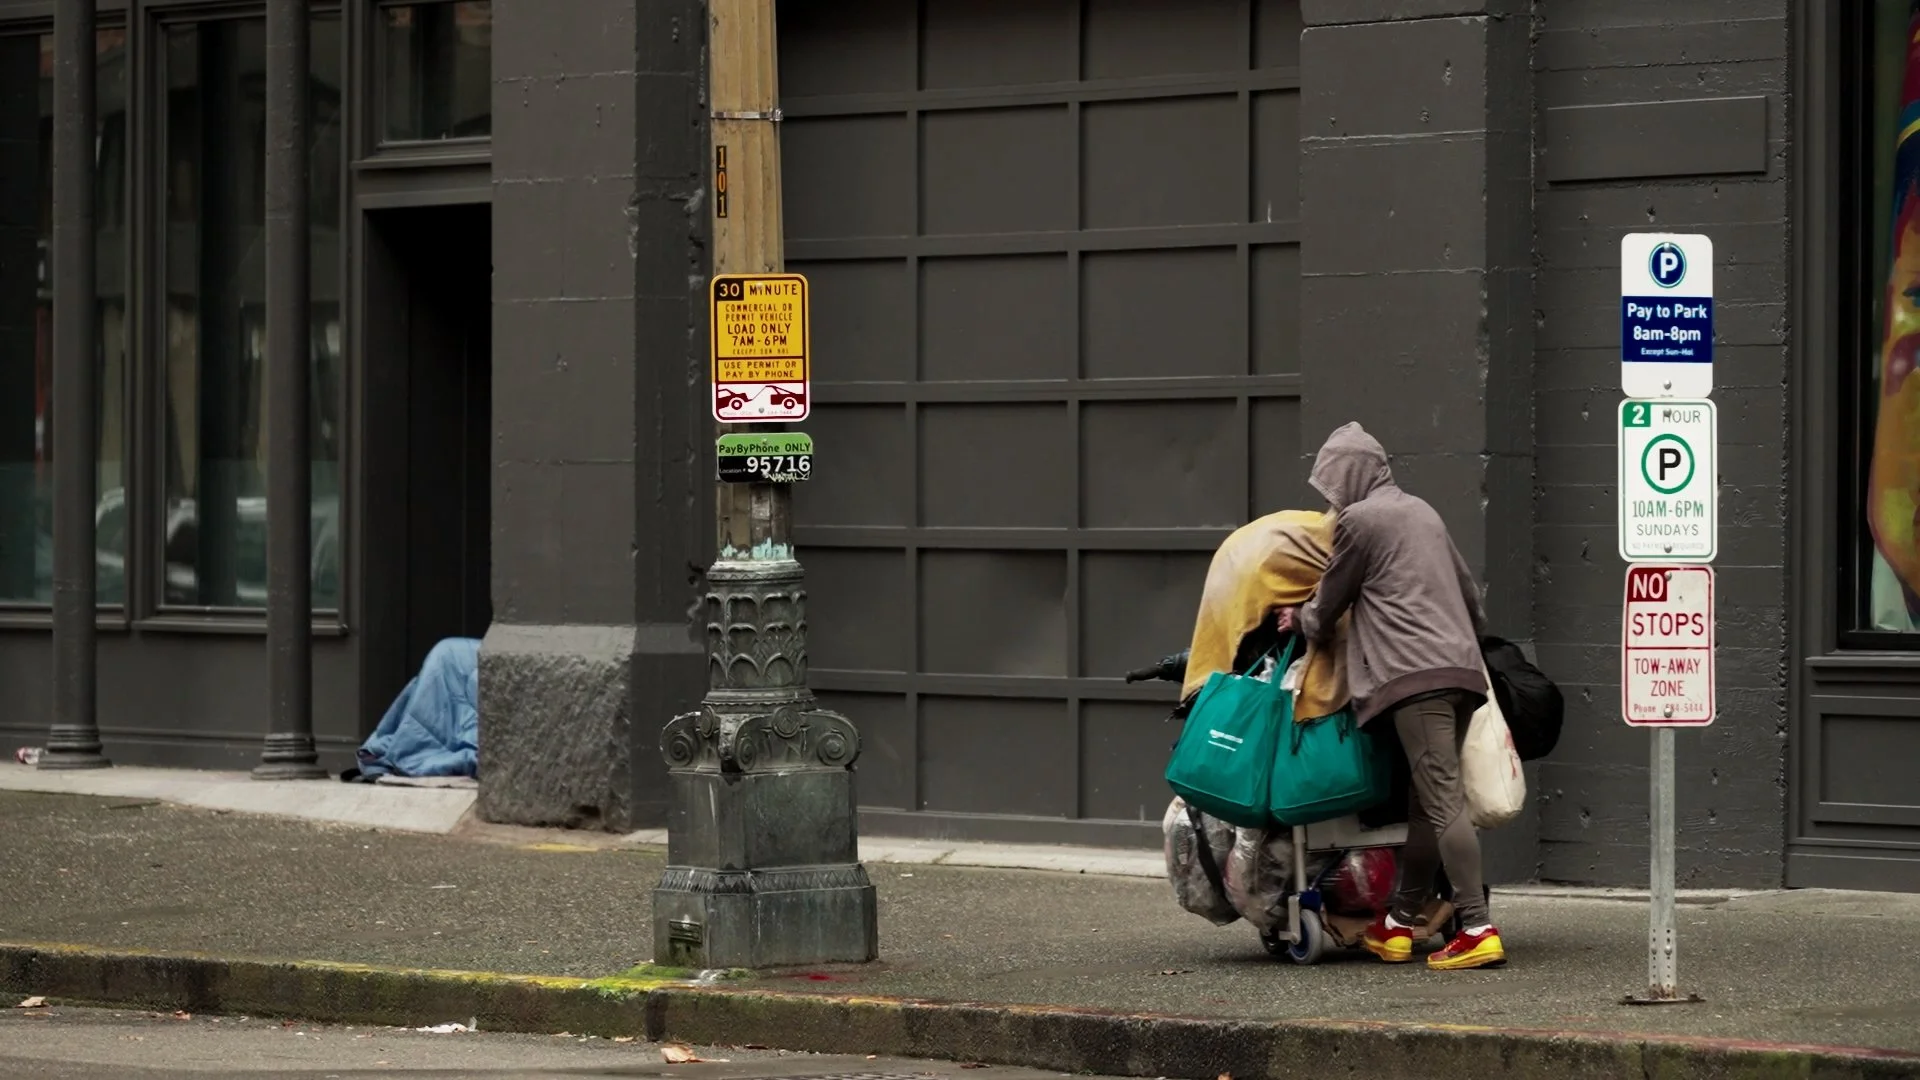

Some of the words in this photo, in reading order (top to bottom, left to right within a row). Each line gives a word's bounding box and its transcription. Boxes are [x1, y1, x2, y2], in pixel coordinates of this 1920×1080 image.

[718, 147, 727, 217] 101
[1660, 252, 1679, 279] P
[719, 283, 740, 297] 30
[749, 284, 798, 296] MINUTE
[725, 303, 777, 313] COMMERCIAL
[782, 303, 793, 312] OR
[1627, 302, 1653, 321] Pay
[1656, 304, 1671, 318] to
[1674, 303, 1708, 319] Park
[725, 313, 755, 322] PERMIT
[760, 312, 793, 321] VEHICLE
[727, 323, 756, 335] LOAD
[761, 323, 791, 334] ONLY
[1633, 325, 1701, 344] 8am-8pm
[1641, 347, 1664, 357] Except
[724, 361, 741, 369] USE
[747, 361, 780, 369] PERMIT
[785, 360, 797, 368] OR
[765, 370, 795, 378] PHONE
[1632, 404, 1645, 425] 2
[719, 443, 780, 455] PayByPhone
[784, 442, 811, 452] ONLY
[746, 455, 811, 473] 95716
[1659, 448, 1682, 481] P
[1632, 500, 1704, 518] 10AM-6PM
[1636, 523, 1699, 536] SUNDAYS
[1632, 572, 1664, 600] NO
[1632, 612, 1704, 636] STOPS
[1634, 657, 1701, 675] TOW-AWAY
[1650, 680, 1685, 697] ZONE
[1633, 703, 1657, 713] Phone
